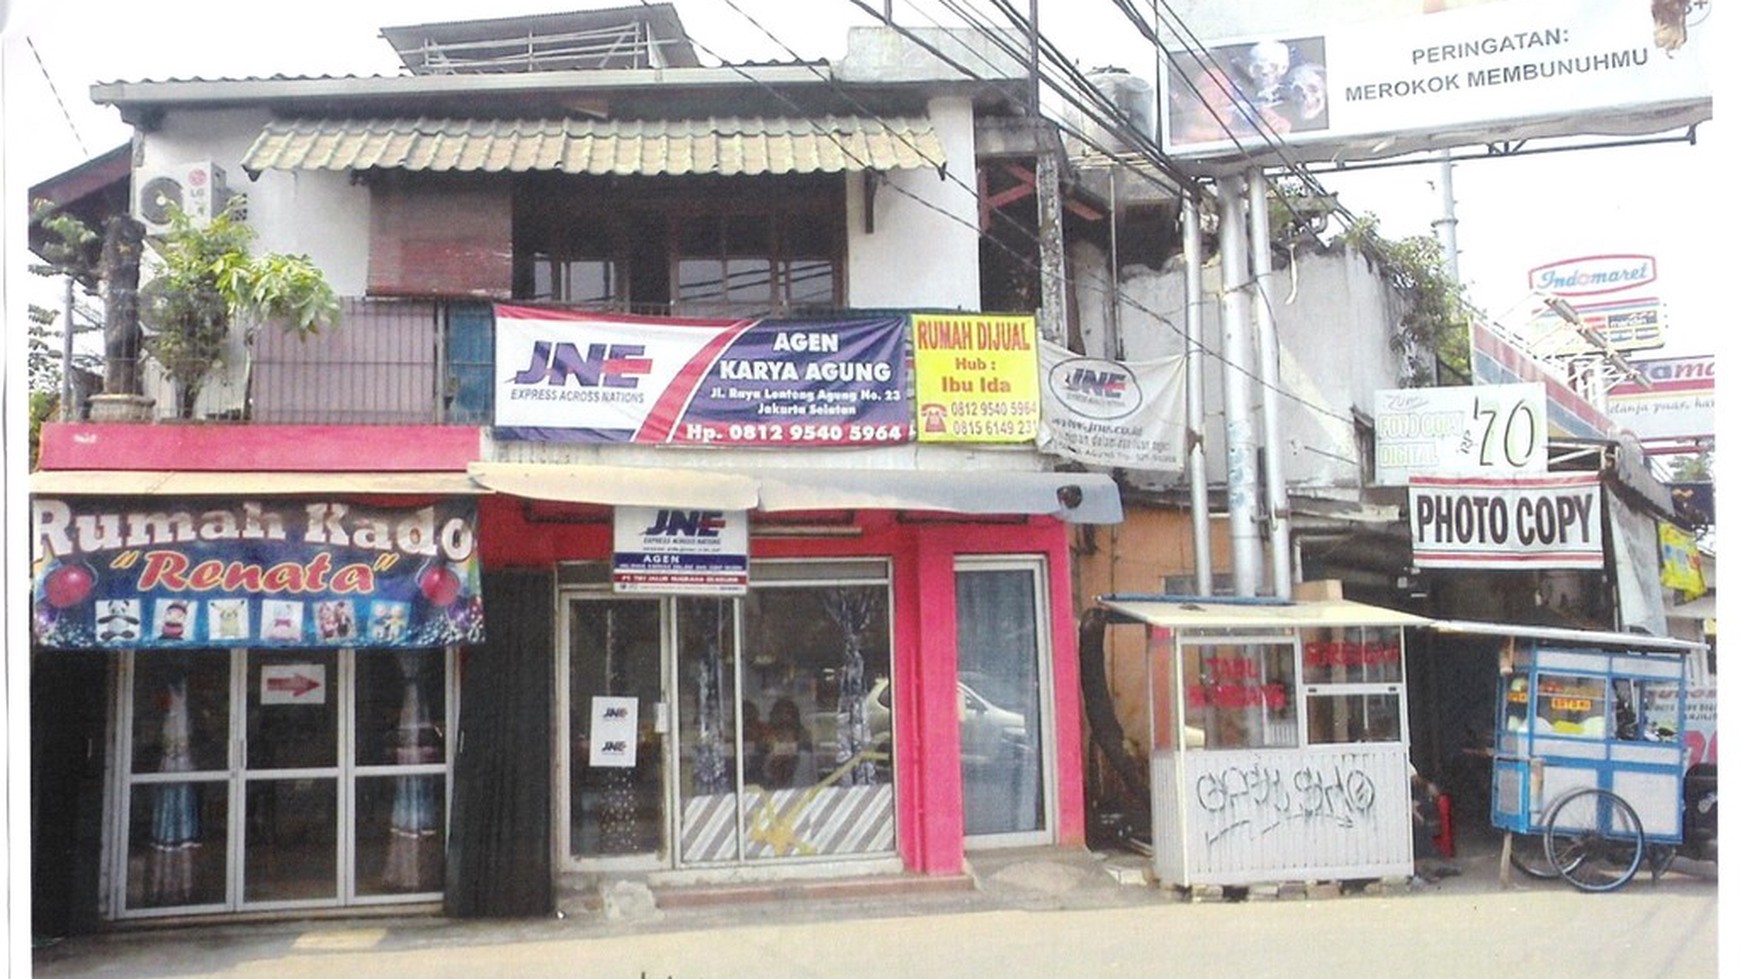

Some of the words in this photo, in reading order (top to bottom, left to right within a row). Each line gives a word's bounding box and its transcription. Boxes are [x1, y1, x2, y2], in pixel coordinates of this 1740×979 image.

[1412, 28, 1570, 65] PERINGATAN:
[1345, 73, 1461, 103] MEROKOK
[1467, 48, 1649, 88] MEMBUNUHMU
[1537, 263, 1649, 289] Indomaret
[773, 332, 839, 352] AGEN
[917, 320, 973, 350] RUMAH
[976, 321, 1031, 350] DIJUAL
[505, 340, 654, 389] JNE
[719, 360, 799, 381] KARYA
[804, 362, 892, 382] AGUNG
[955, 358, 987, 370] Hub
[941, 376, 973, 392] Ibu
[980, 377, 1011, 392] Ida
[1063, 368, 1127, 399] JNE
[511, 388, 558, 401] EXPRESS
[558, 389, 600, 403] ACROSS
[601, 391, 644, 405] NATIONS
[710, 388, 726, 399] Jl.
[729, 388, 760, 401] Raya
[764, 389, 815, 402] Lenteng
[816, 389, 857, 403] Agung
[860, 389, 882, 401] No.
[884, 390, 901, 401] 23
[757, 404, 805, 415] Jakarta
[809, 403, 857, 416] Selatan
[951, 401, 978, 416] 0812
[980, 402, 1008, 416] 9540
[685, 424, 722, 442] Hp.
[729, 424, 783, 440] 0812
[789, 425, 843, 441] 9540
[849, 425, 902, 441] 5964
[952, 420, 982, 436] 0815
[985, 421, 1014, 436] 6149
[32, 499, 287, 561] Rumah
[303, 502, 474, 561] Kado
[639, 509, 727, 537] JNE
[1417, 495, 1509, 545] PHOTO
[1516, 493, 1593, 547] COPY
[643, 554, 681, 564] AGEN
